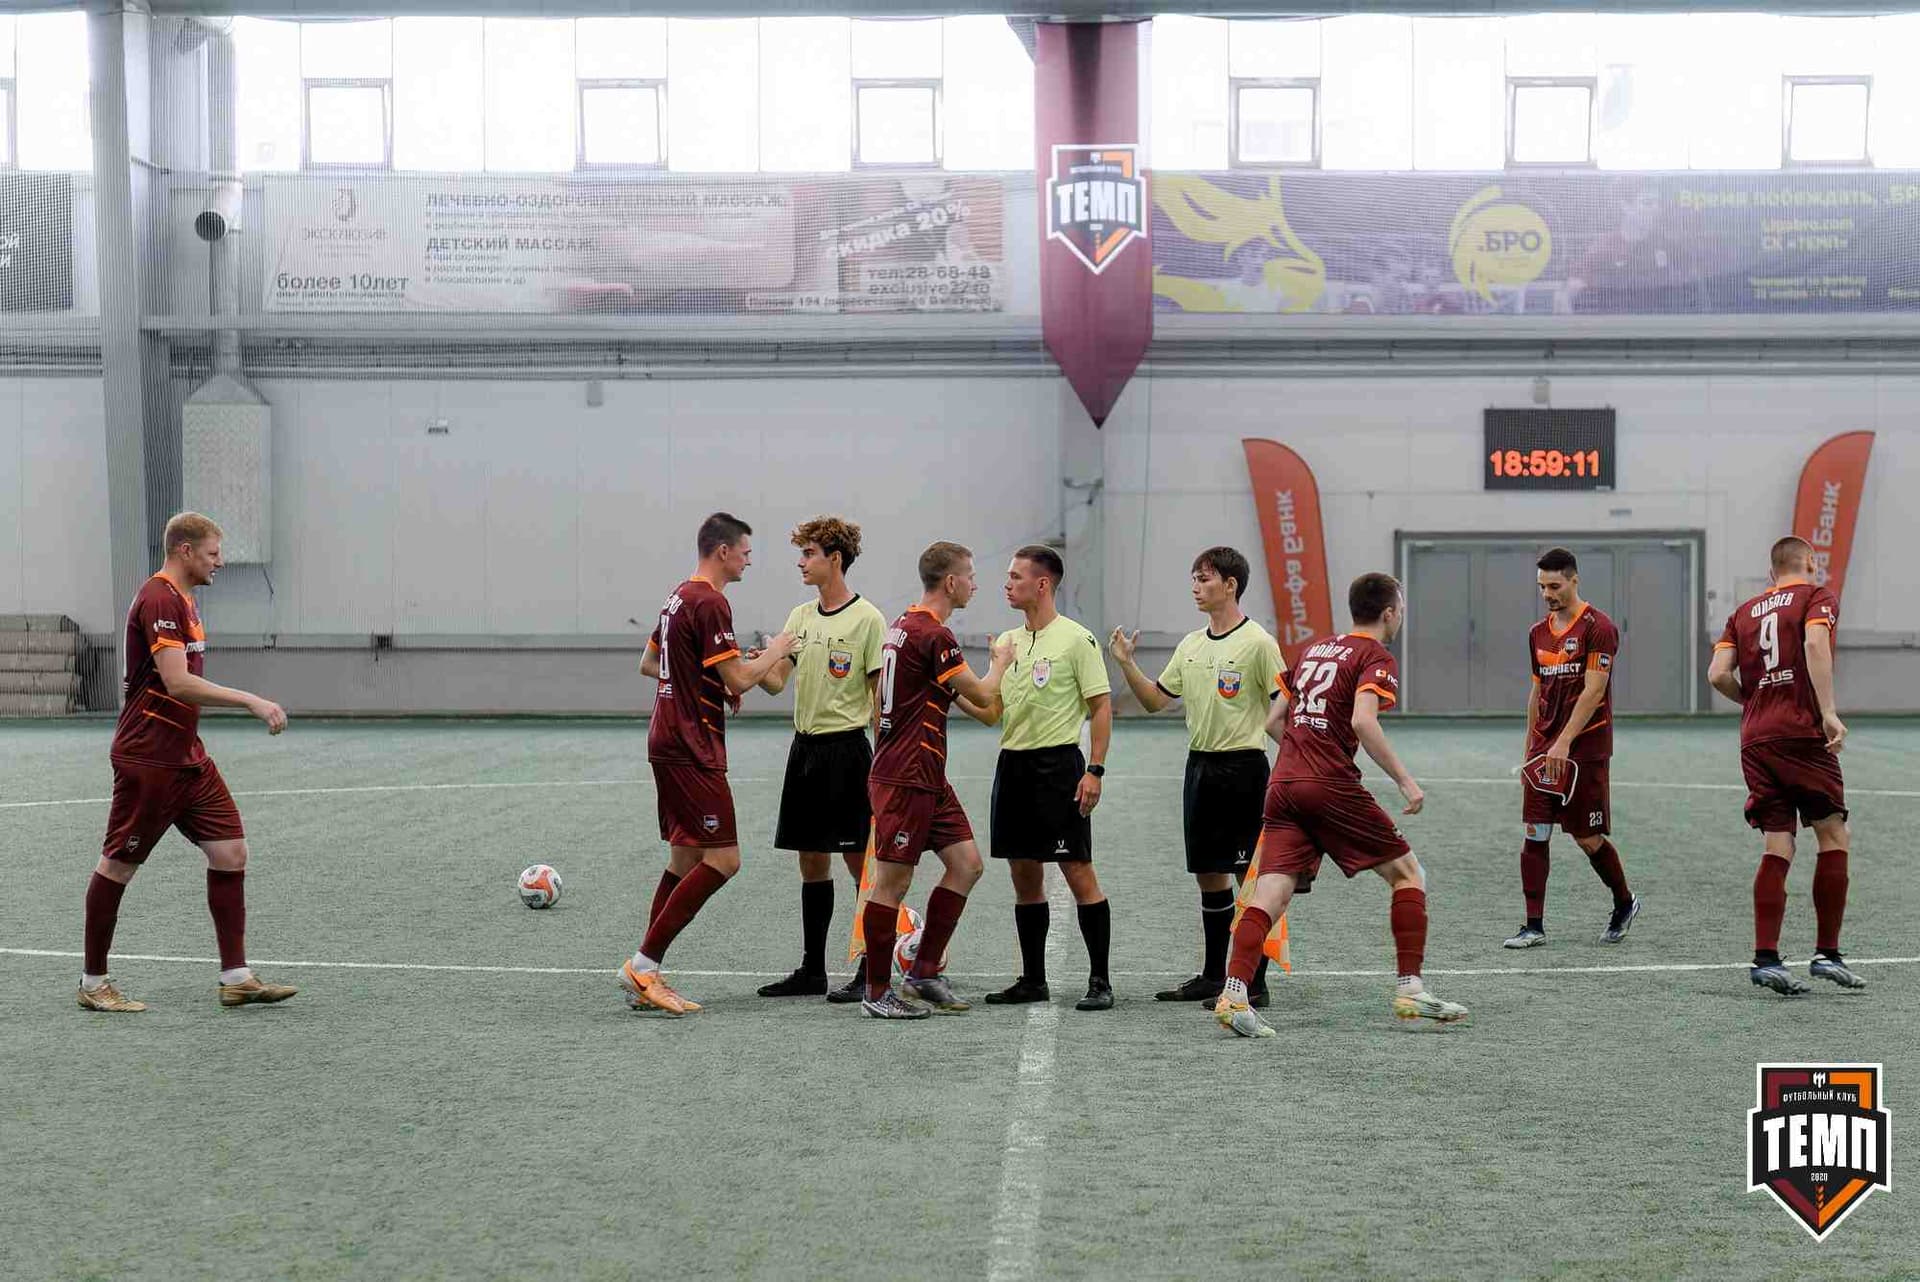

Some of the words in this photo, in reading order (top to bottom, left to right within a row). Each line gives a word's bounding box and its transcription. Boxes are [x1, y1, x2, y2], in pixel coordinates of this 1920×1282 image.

[1056, 180, 1137, 224] ТЕМП
[426, 235, 509, 252] ДЕТСКИЙ
[825, 222, 911, 260] скидка
[916, 199, 971, 231] 20%
[277, 272, 341, 290] более
[1490, 450, 1599, 476] 18:59:11
[1812, 481, 1842, 546] Банк
[1760, 612, 1780, 671] 9
[1293, 661, 1338, 714] 72
[1589, 811, 1603, 827] 23
